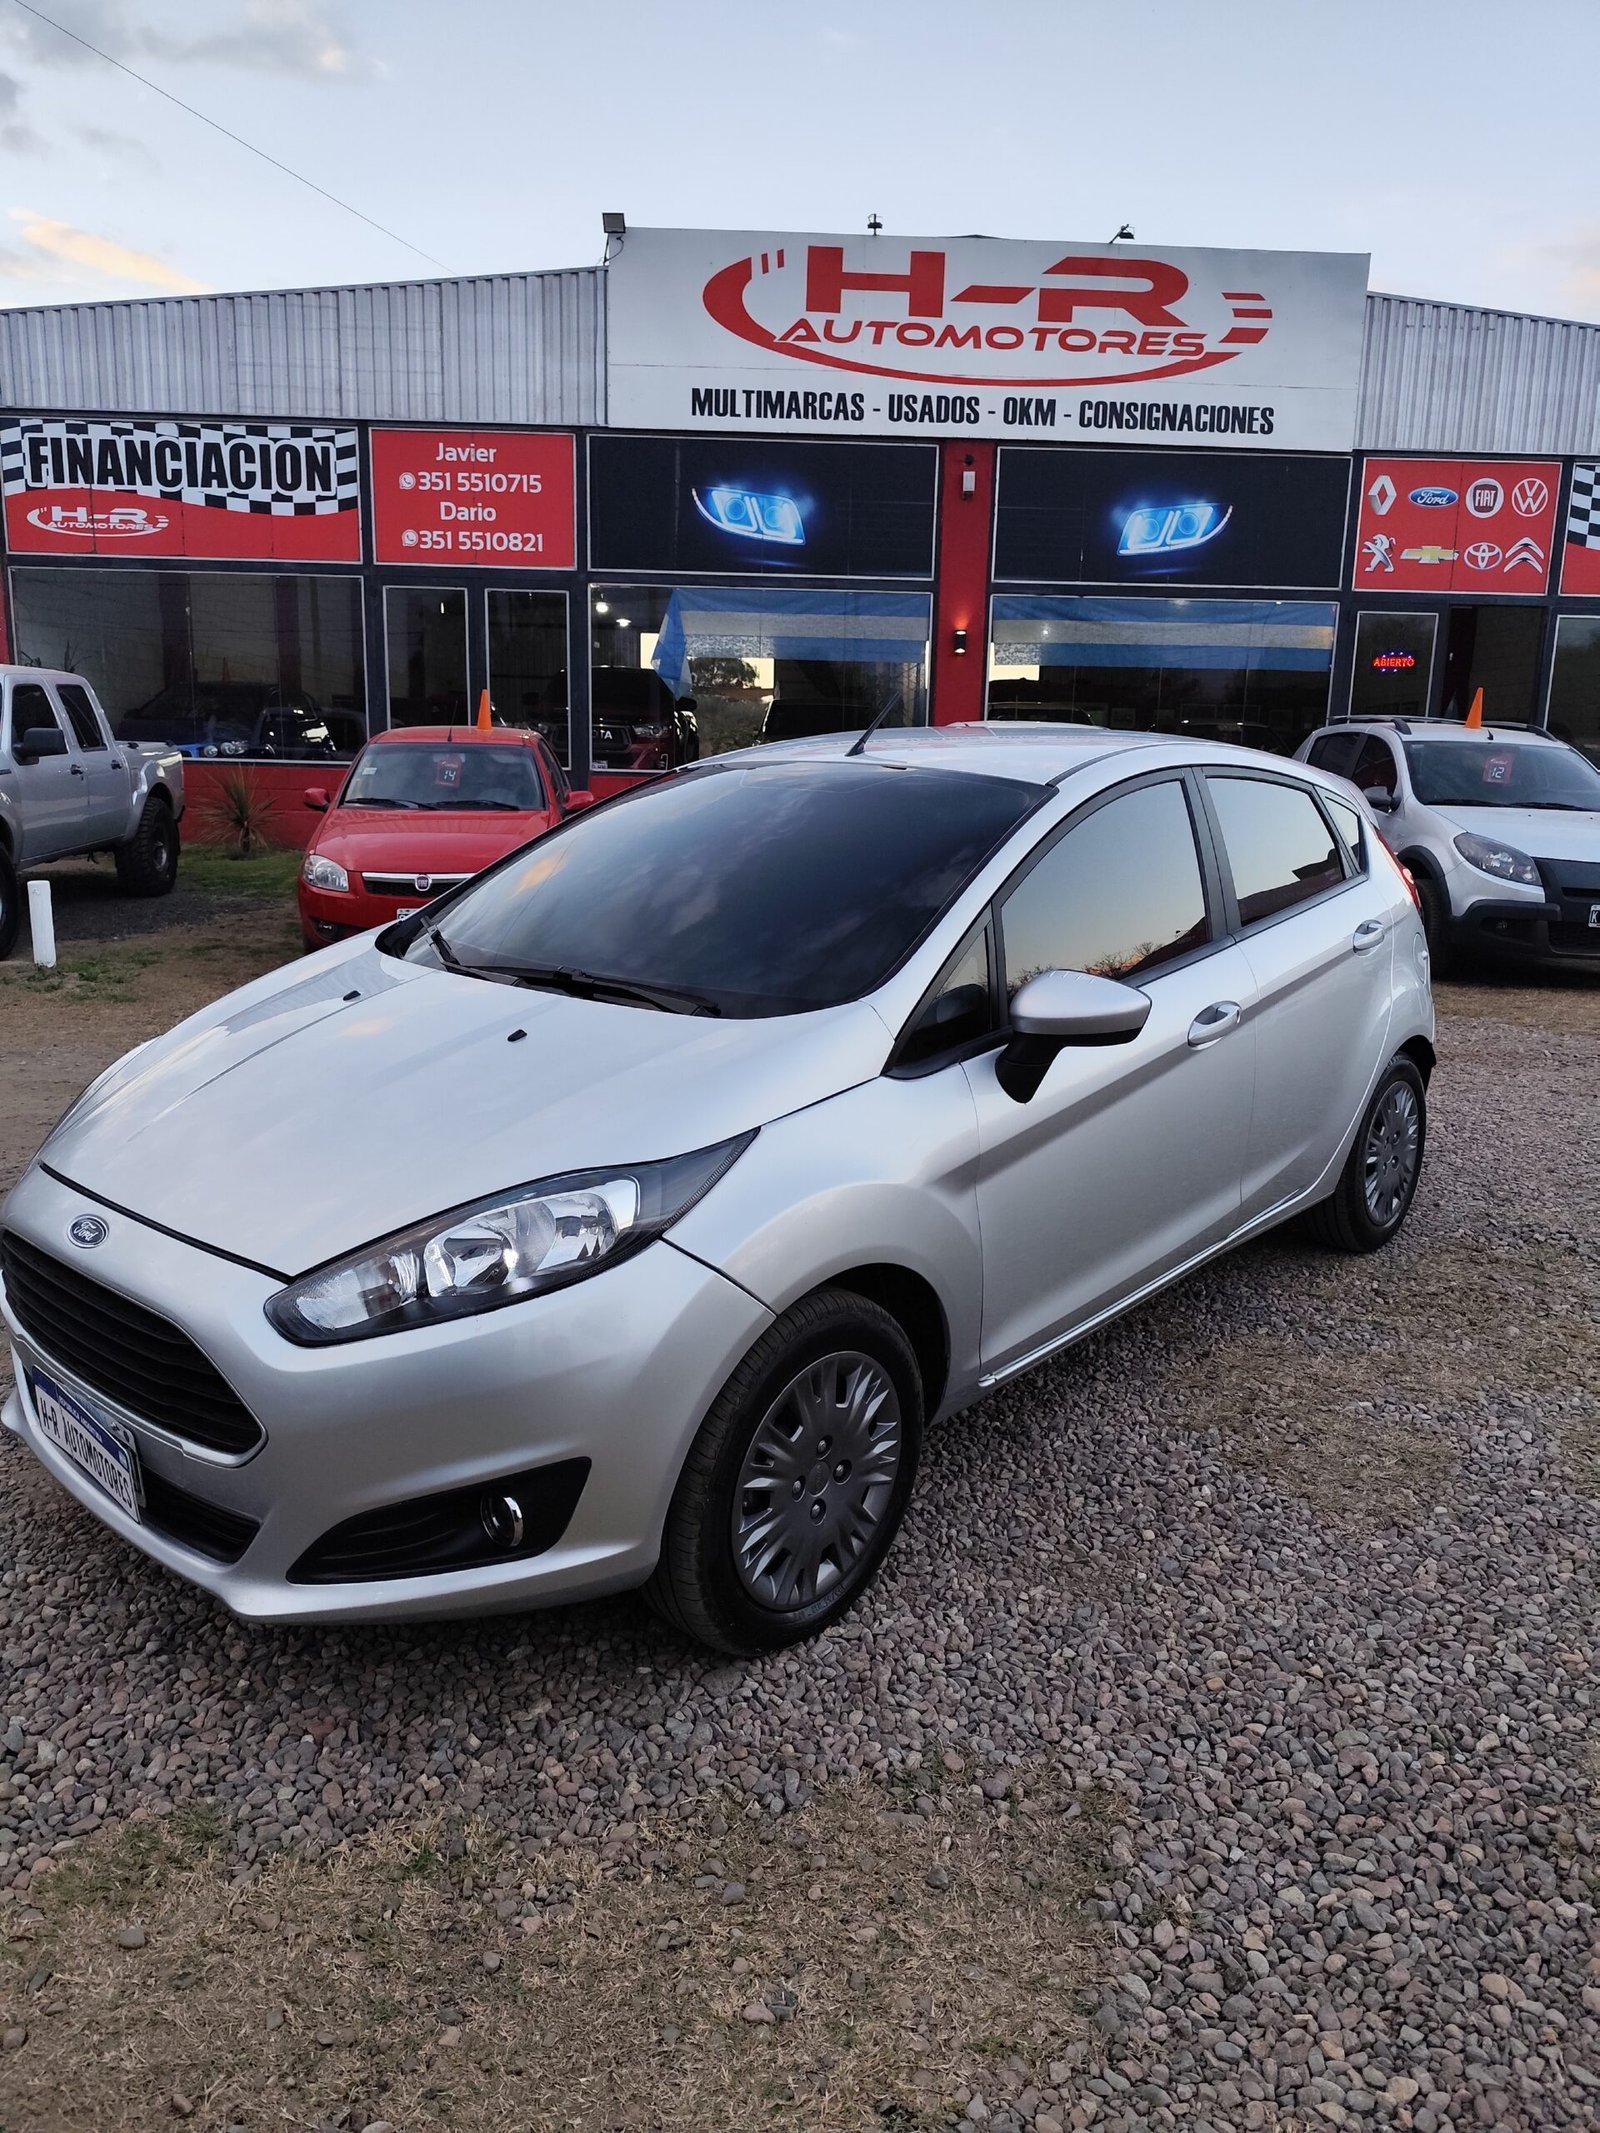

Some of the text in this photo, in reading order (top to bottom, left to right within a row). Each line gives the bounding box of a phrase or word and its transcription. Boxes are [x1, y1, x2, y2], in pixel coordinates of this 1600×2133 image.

[805, 245, 1188, 327] H-R
[774, 317, 1208, 358] AUTOMOTORES
[691, 388, 865, 421] MULTIMARCAS
[888, 394, 980, 425] USADOS
[1078, 400, 1275, 435] CONSIGNACIONES
[436, 442, 497, 463] Javier
[26, 436, 333, 493] FINANCIACION
[417, 471, 542, 494] 351 5510715
[1416, 490, 1449, 507] Ford
[1475, 489, 1496, 507] FIAT
[51, 506, 149, 524] H-R
[440, 501, 497, 522] Dario
[47, 521, 155, 531] AUTOMOTORES
[419, 530, 543, 552] 351 5510821
[1373, 656, 1415, 667] ABIERTO
[443, 769, 457, 781] 14
[1491, 766, 1505, 778] 12
[73, 1220, 99, 1242] Ford
[40, 1397, 61, 1439] H-R
[62, 1415, 133, 1510] AUTOMOTORES
